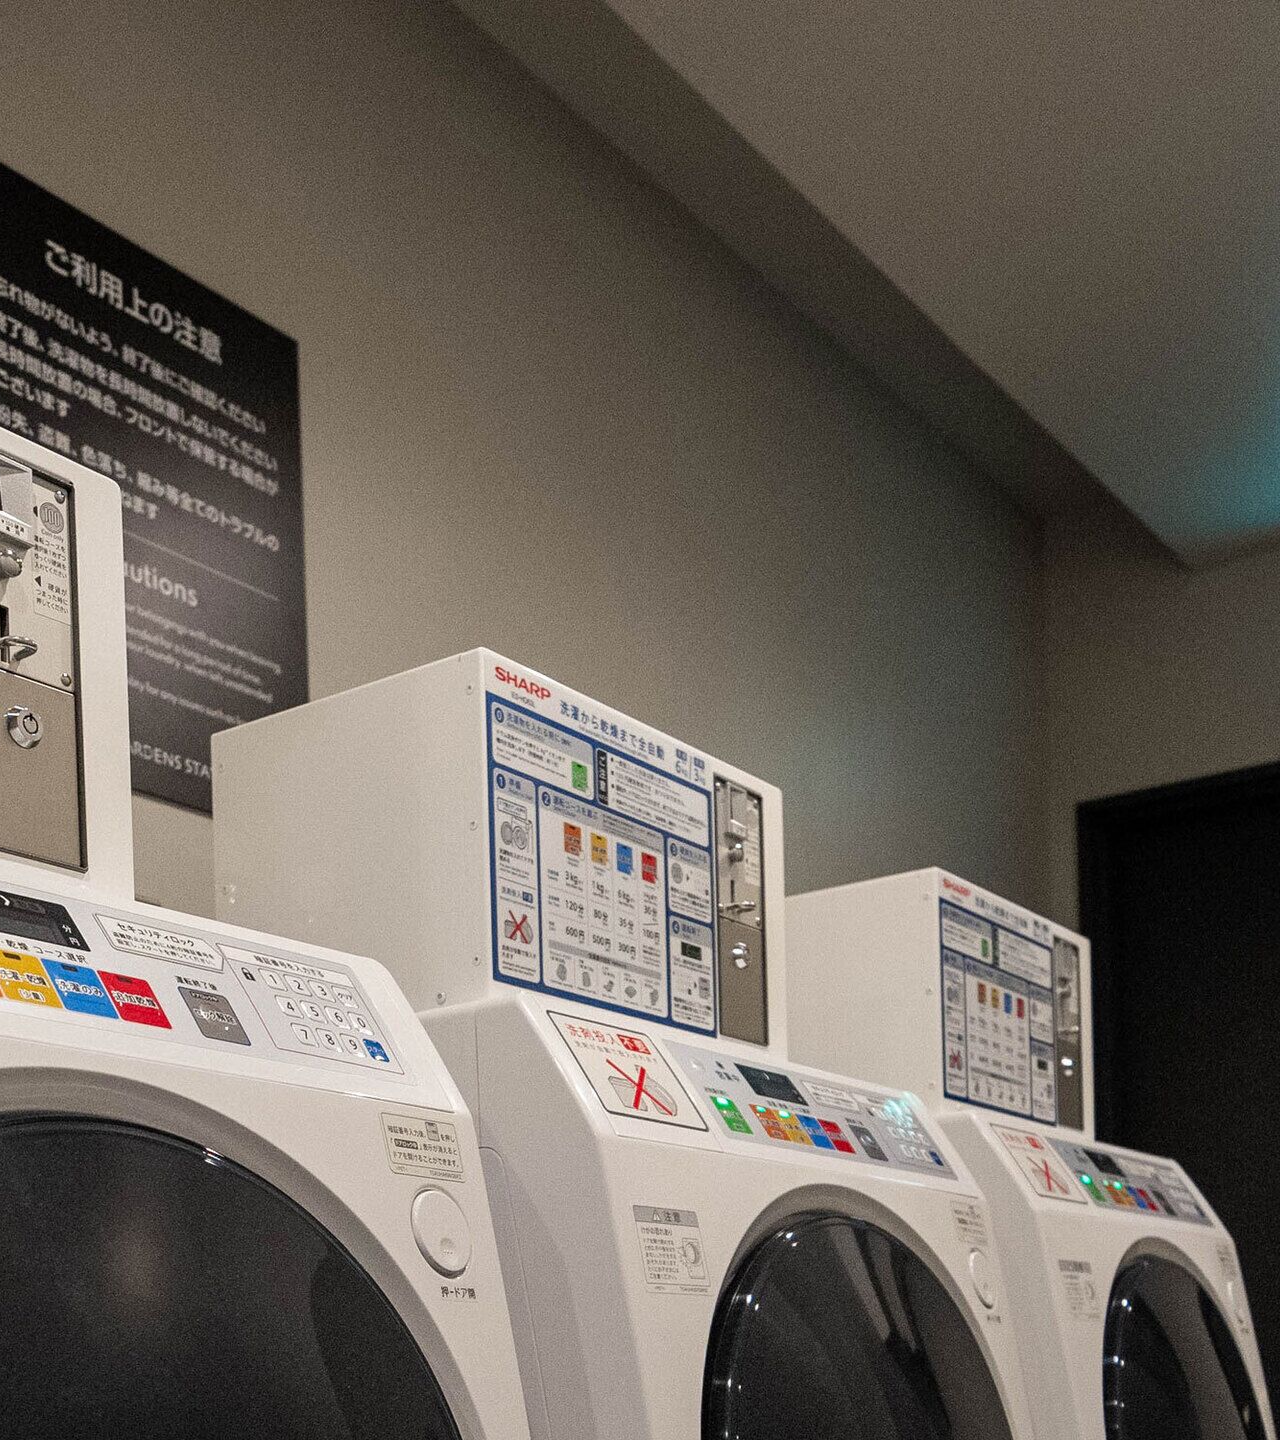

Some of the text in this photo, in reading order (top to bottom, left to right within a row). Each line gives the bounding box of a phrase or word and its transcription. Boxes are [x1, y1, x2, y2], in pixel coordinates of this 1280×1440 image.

[44, 236, 222, 368] ご利用上の注意
[494, 665, 551, 700] SHARP
[117, 923, 195, 947] セキュリティロック
[57, 977, 104, 999] 洗濯のみ
